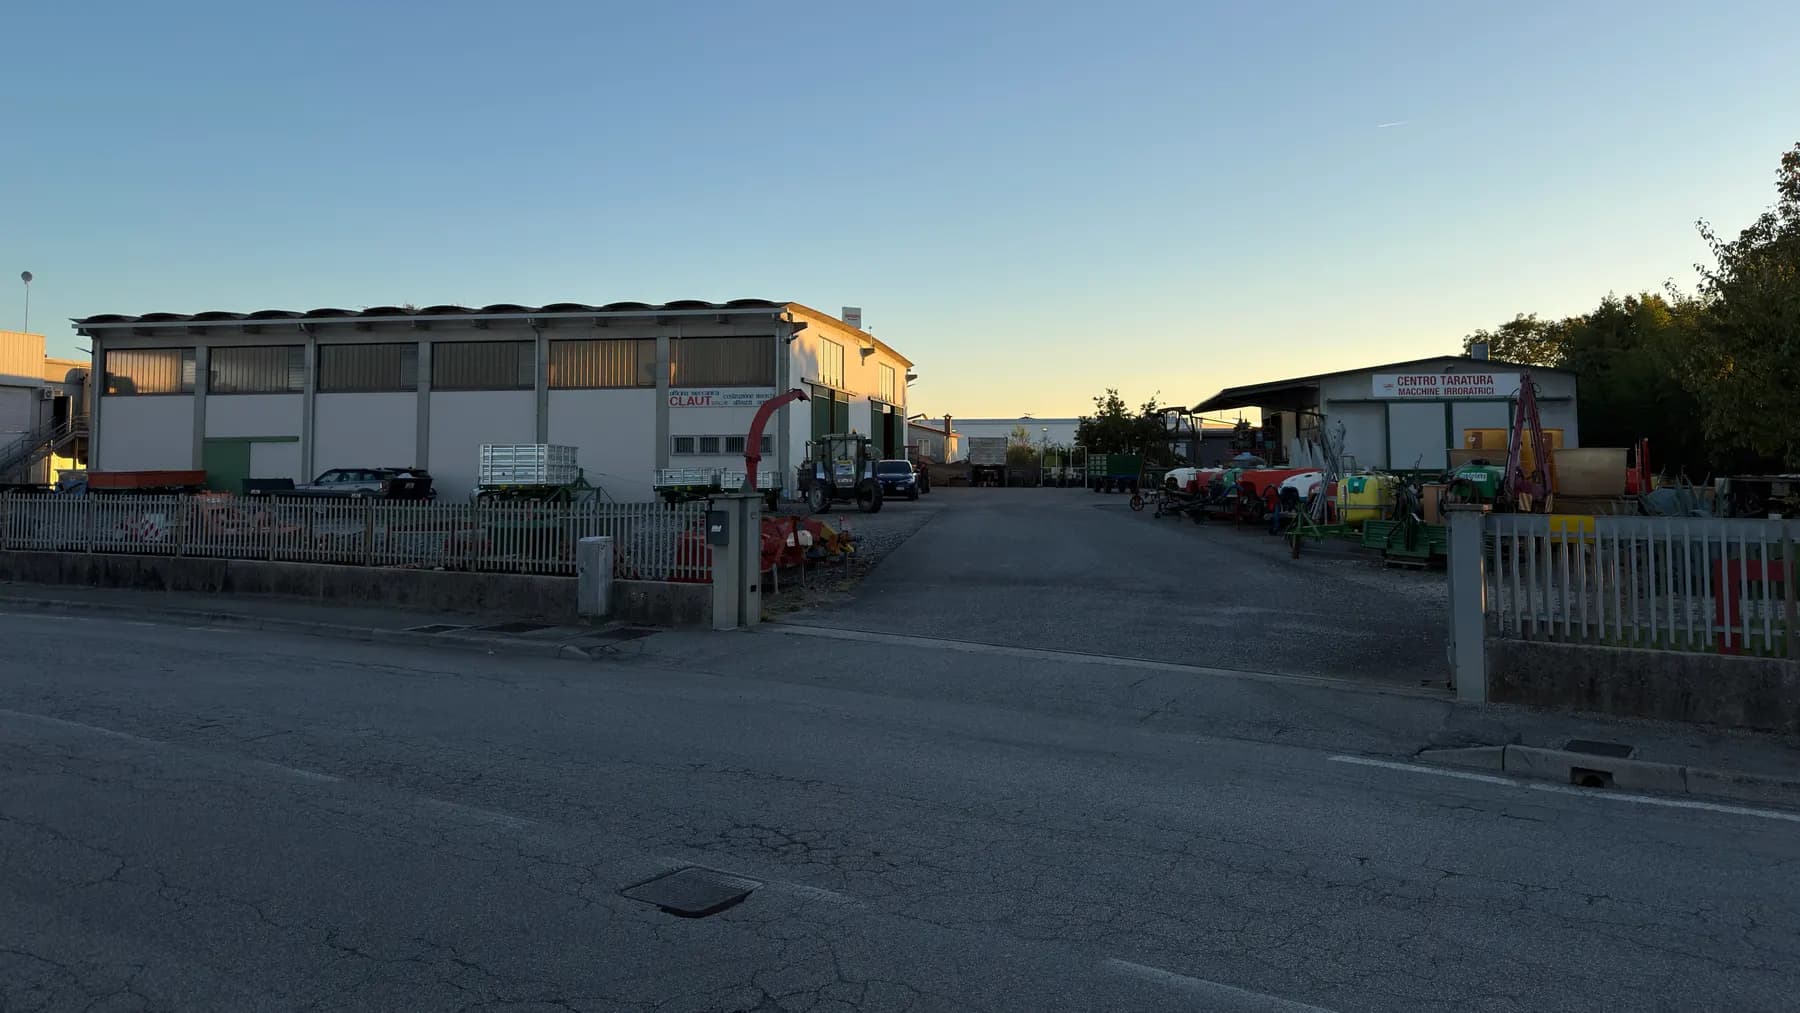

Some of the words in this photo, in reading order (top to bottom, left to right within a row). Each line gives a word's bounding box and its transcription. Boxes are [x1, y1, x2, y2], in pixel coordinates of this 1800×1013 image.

[1397, 375, 1437, 386] CENTRO
[1440, 375, 1494, 385] TARATURA
[1398, 387, 1440, 396] MACCHINE
[1444, 387, 1495, 396] IRRORATRICI
[669, 396, 712, 406] CLAUT
